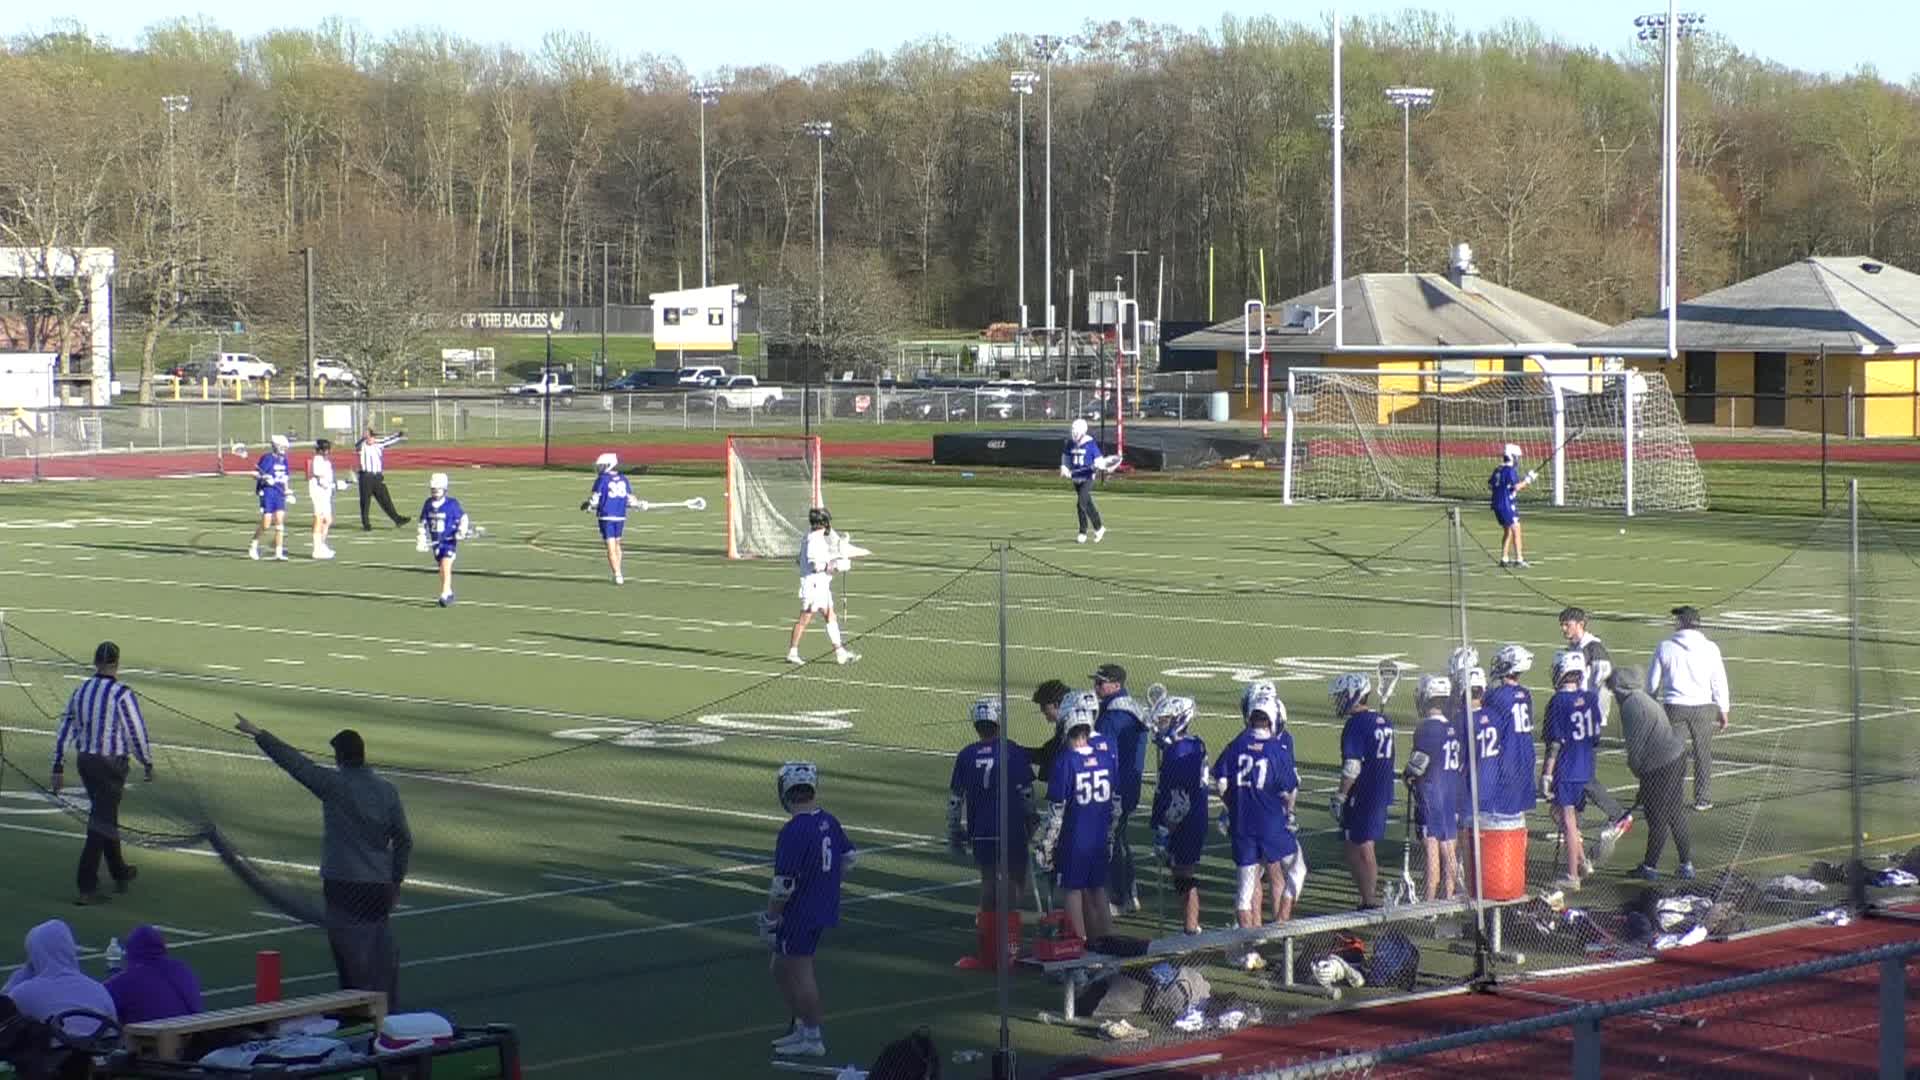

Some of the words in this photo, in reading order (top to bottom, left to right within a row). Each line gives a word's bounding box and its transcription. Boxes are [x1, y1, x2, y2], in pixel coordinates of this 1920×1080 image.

[478, 312, 502, 328] THE
[503, 312, 548, 328] EAGLES
[608, 480, 627, 498] 38
[1511, 703, 1531, 733] 16
[1570, 708, 1593, 740] 31
[1374, 727, 1393, 759] 27
[1442, 739, 1460, 770] 13
[1476, 727, 1500, 757] 12
[975, 758, 994, 789] 7
[1075, 769, 1111, 804] 55
[1237, 754, 1268, 790] 21
[822, 836, 833, 872] 6
